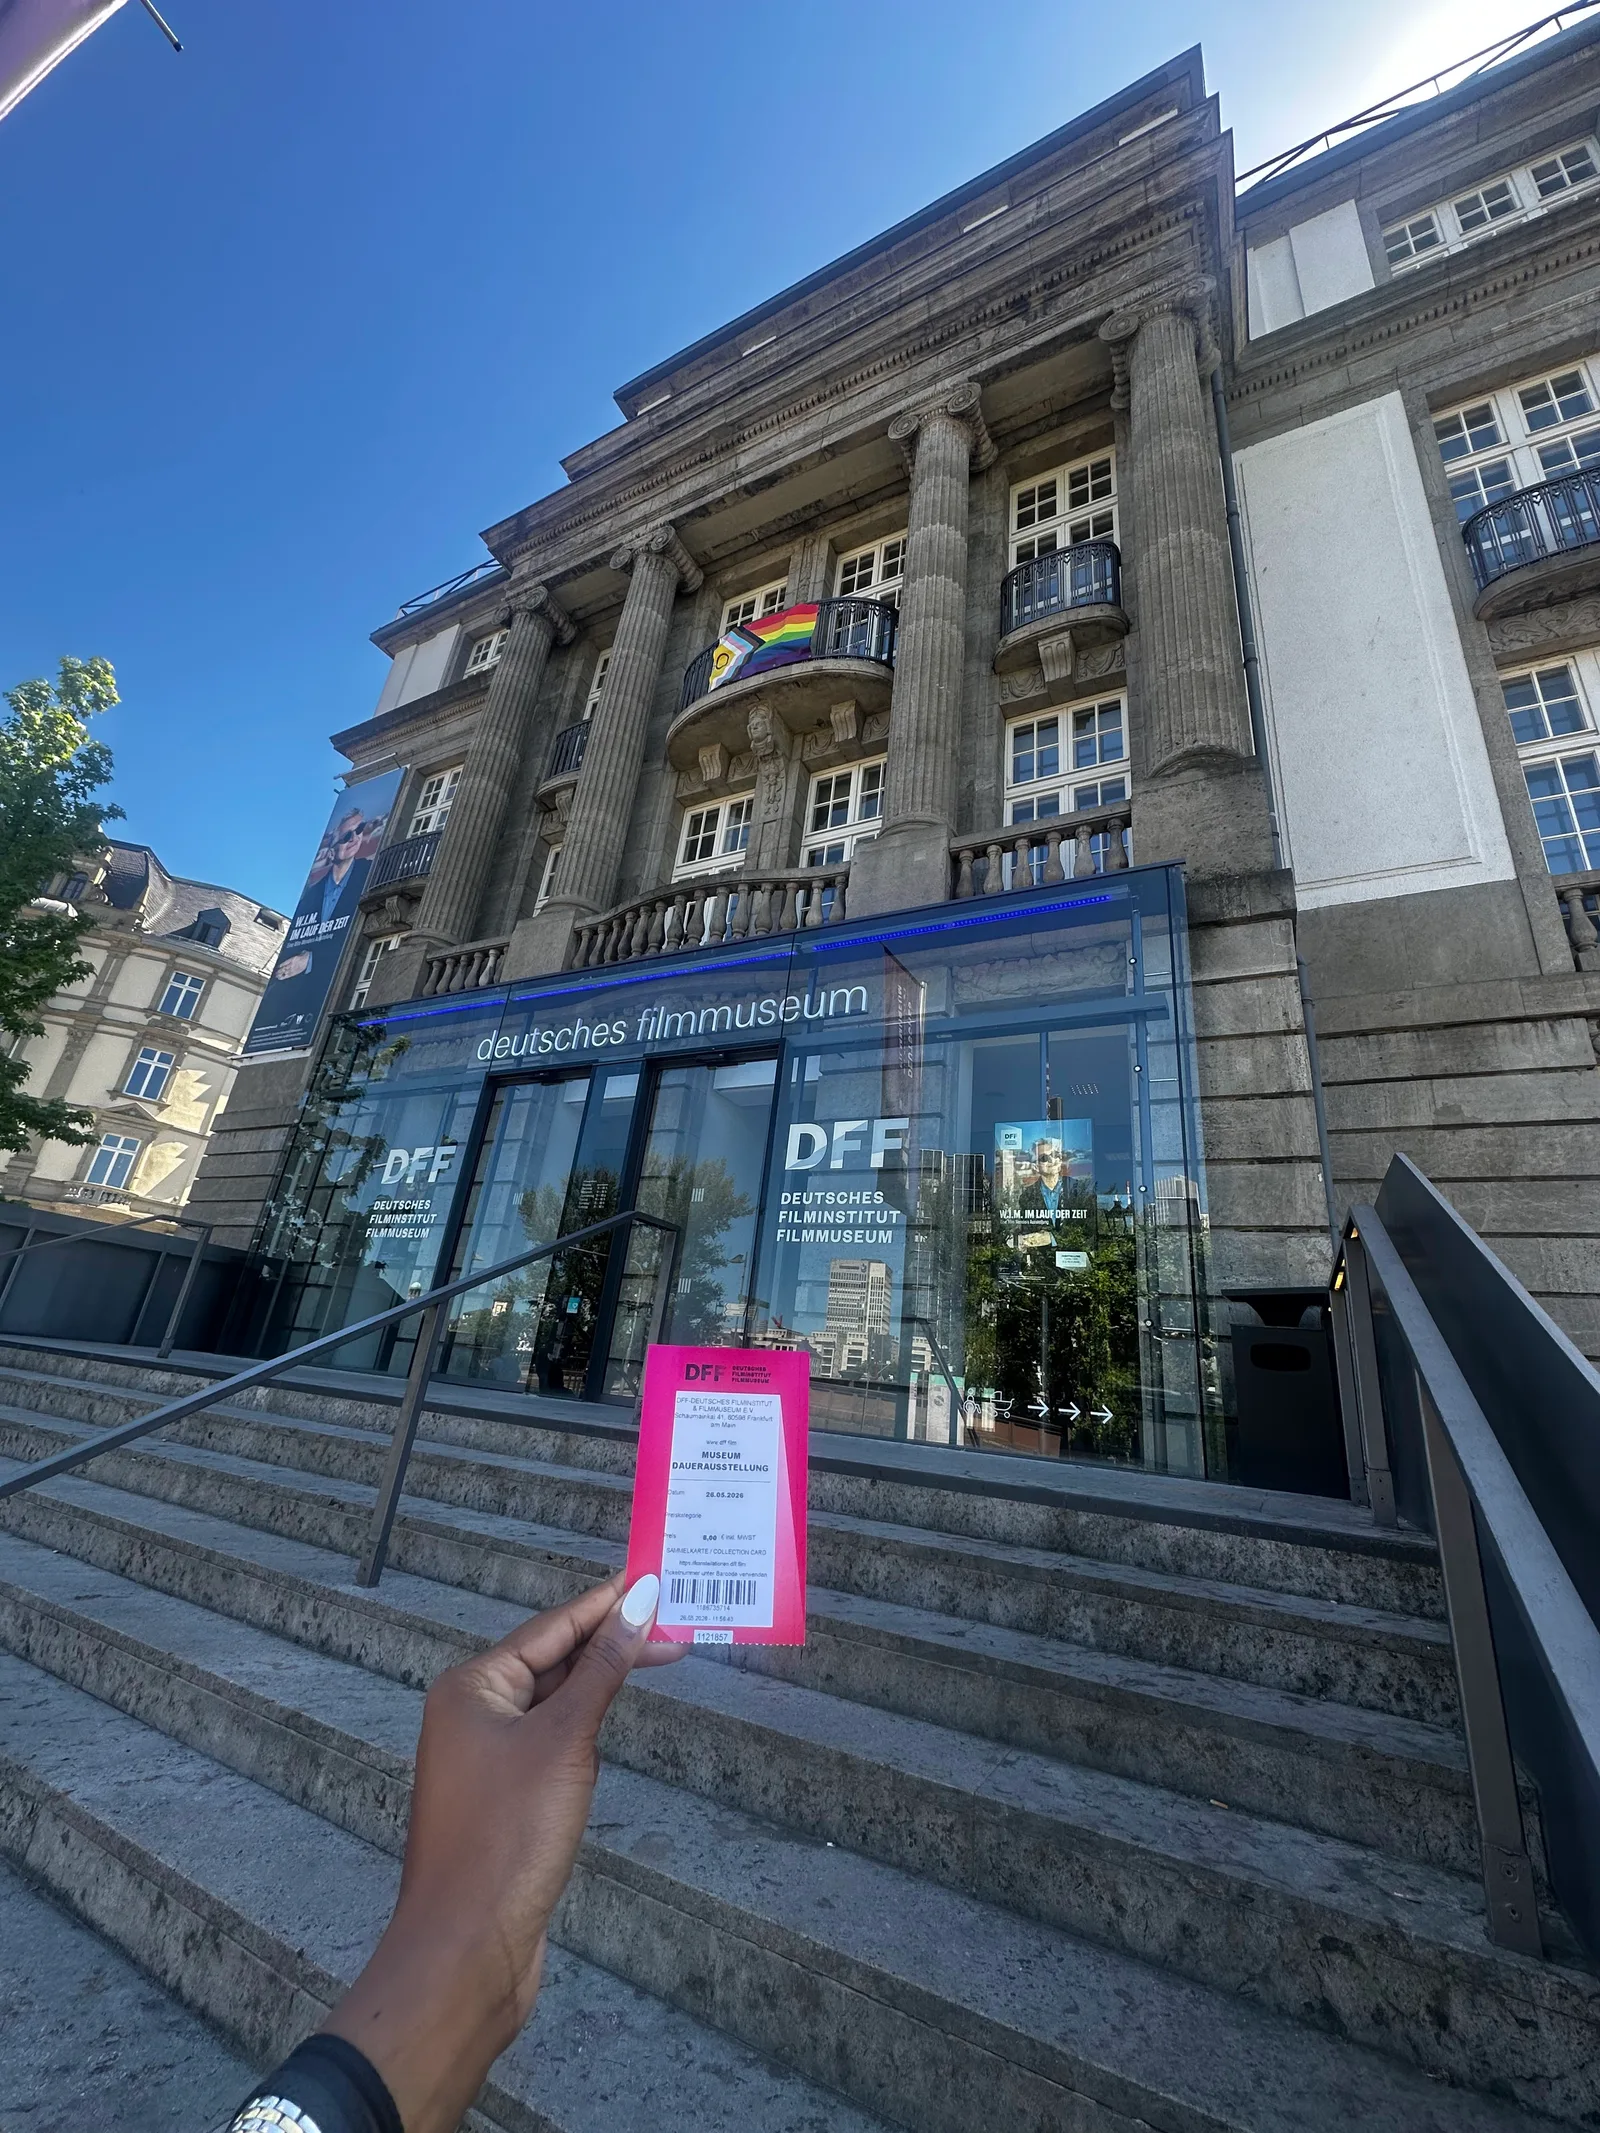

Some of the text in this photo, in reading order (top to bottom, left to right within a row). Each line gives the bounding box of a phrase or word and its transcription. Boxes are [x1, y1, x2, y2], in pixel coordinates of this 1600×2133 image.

[289, 916, 350, 941] IM LAUF DER ZEIT
[477, 1017, 627, 1061] deutsches
[636, 985, 869, 1041] filmmuseum
[785, 1117, 910, 1170] DFF
[380, 1145, 457, 1185] DFF
[781, 1192, 884, 1205] DEUTSCHES
[374, 1200, 431, 1211] DEUTSCHES
[369, 1214, 437, 1224] FILMINSTITUT
[779, 1210, 901, 1223] FILMINSTITUT
[999, 1209, 1088, 1219] W.I.M. IM LAUF DER ZEIT
[365, 1228, 430, 1238] FILMMUSEUM
[777, 1229, 893, 1243] FILMMUSEUM
[684, 1364, 727, 1382] DFF
[702, 1451, 741, 1460] MUSEUM
[672, 1462, 769, 1472] DAUERAUSSTELLUNG
[697, 1633, 728, 1641] 1121857
